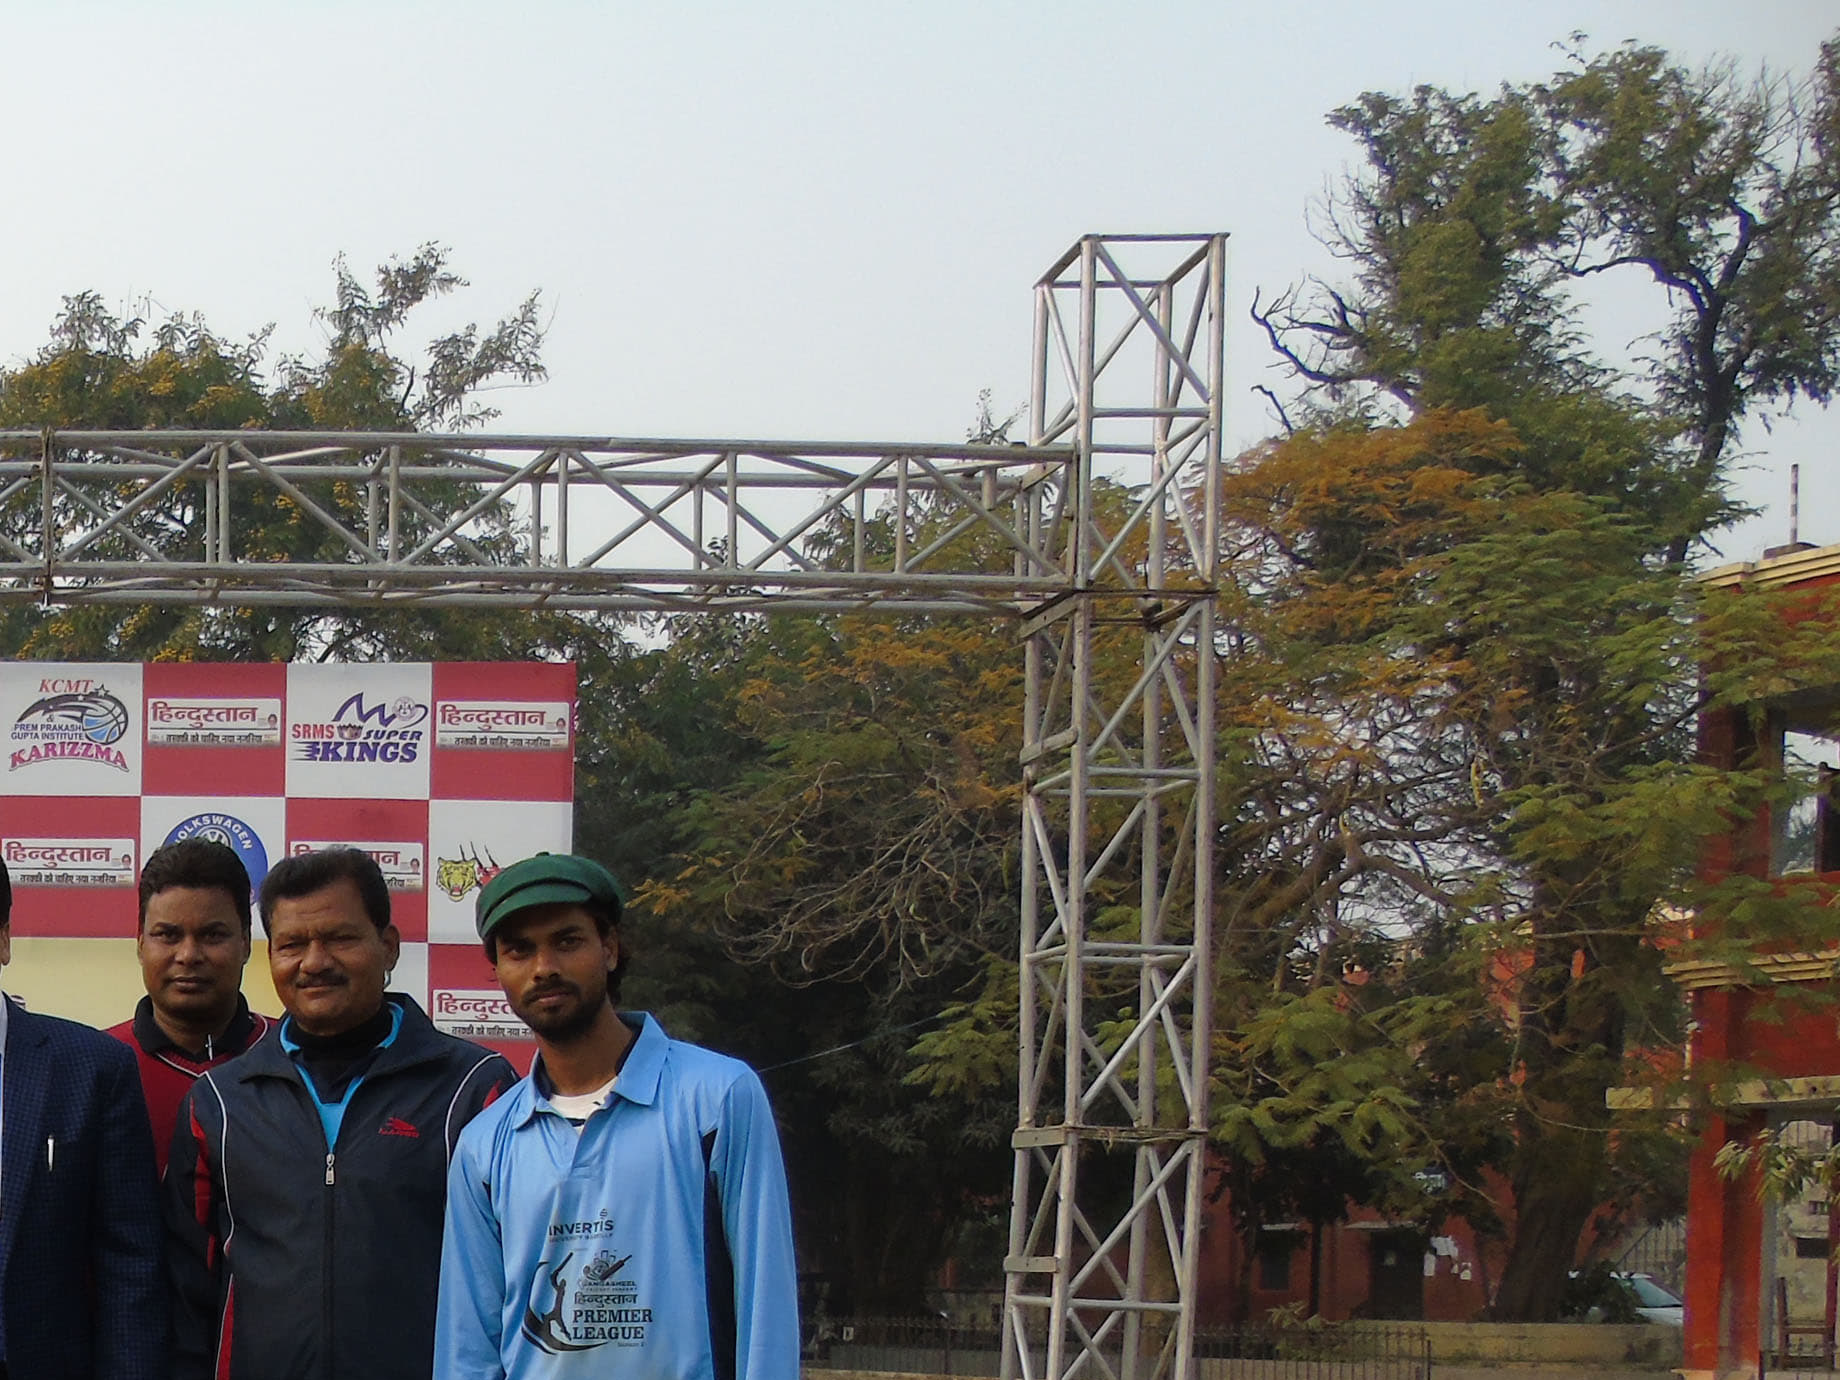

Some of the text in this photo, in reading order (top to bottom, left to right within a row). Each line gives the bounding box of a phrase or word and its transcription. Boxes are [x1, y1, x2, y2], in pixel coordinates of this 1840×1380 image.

[39, 679, 94, 693] KCMT
[46, 713, 55, 723] &
[152, 701, 258, 729] हिन्दुस्तान
[440, 704, 546, 731] हिन्दुस्तान
[14, 723, 81, 732] PREM PRAKASH
[292, 724, 423, 740] SRMS SUPER
[11, 732, 84, 740] GUPTA INSTITUTE
[10, 742, 128, 769] KARIZZMA
[318, 742, 418, 763] KINGS
[4, 841, 112, 868] हिन्दुस्तान
[549, 1219, 614, 1236] INVERTIS
[573, 1309, 652, 1323] PREMIER
[573, 1327, 644, 1340] LEAGUE
